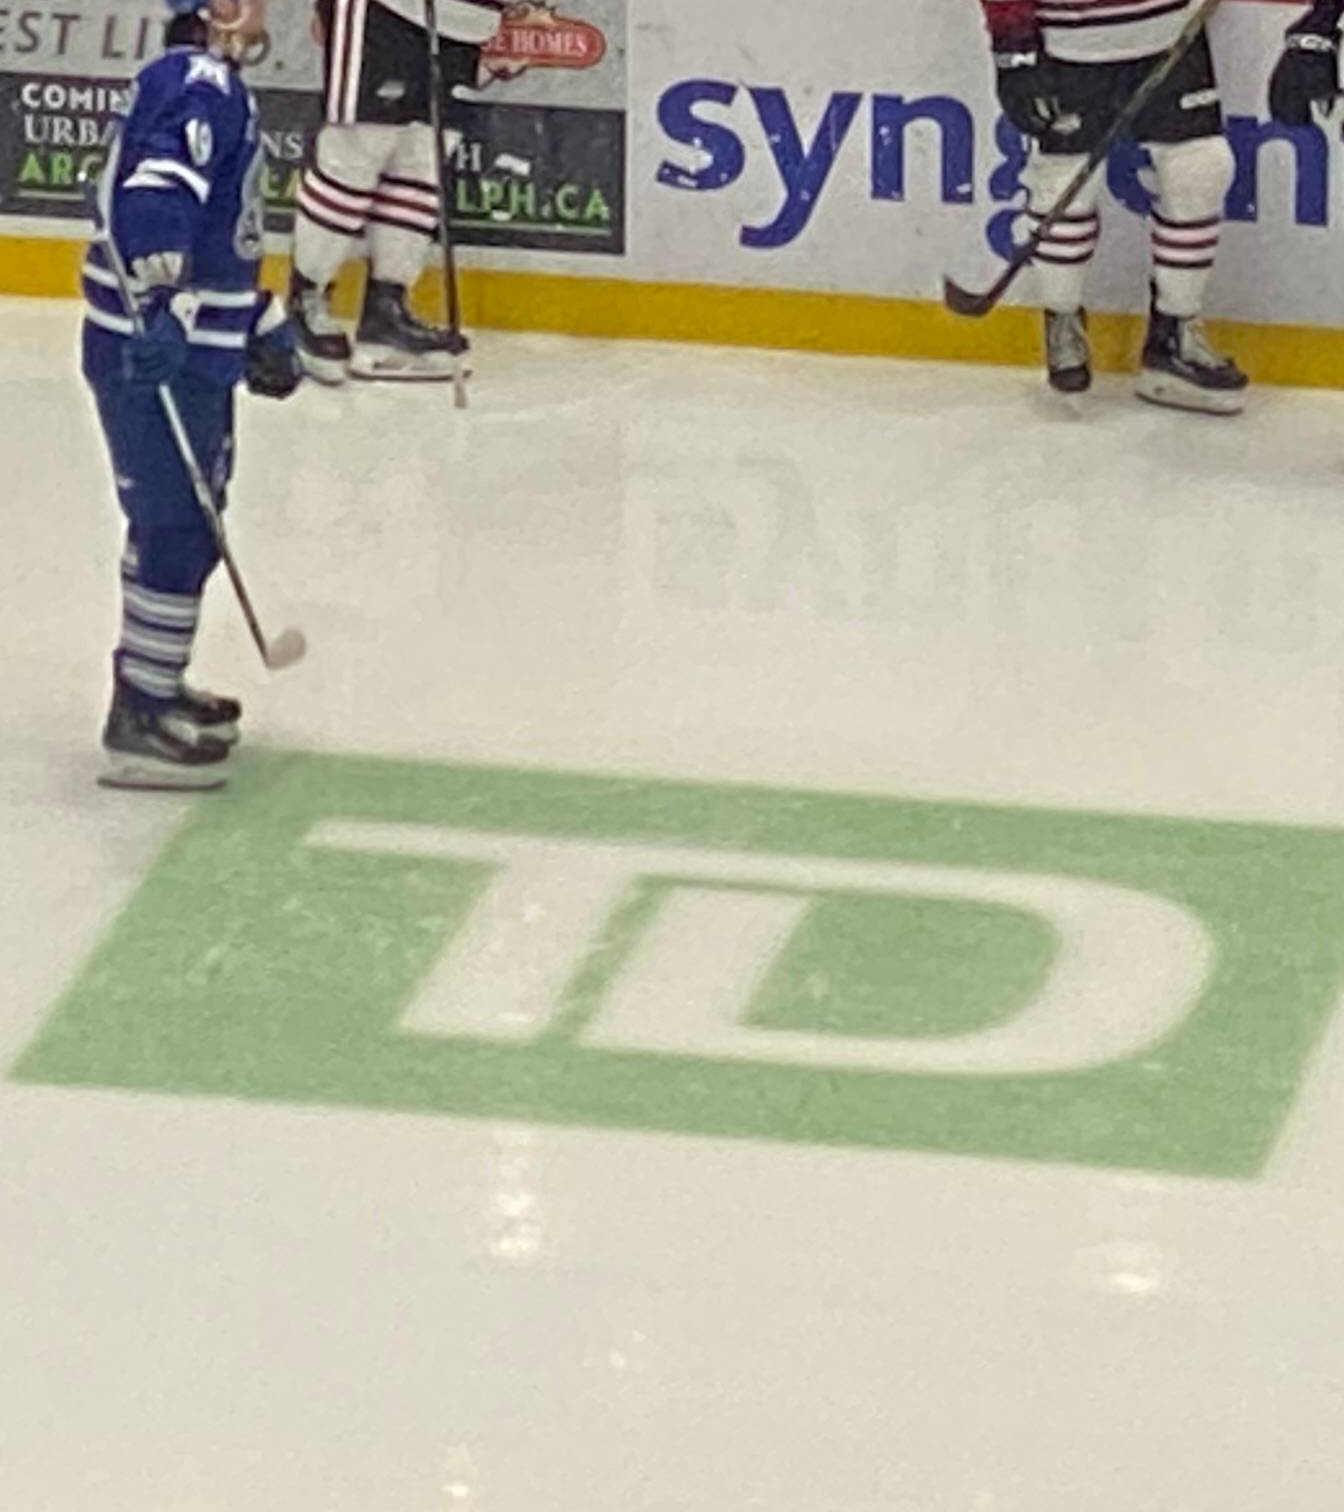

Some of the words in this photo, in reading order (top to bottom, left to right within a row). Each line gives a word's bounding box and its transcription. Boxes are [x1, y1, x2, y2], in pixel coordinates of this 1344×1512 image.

[512, 28, 589, 58] HOMES
[20, 81, 131, 112] COMIN
[305, 817, 1213, 1075] TD
